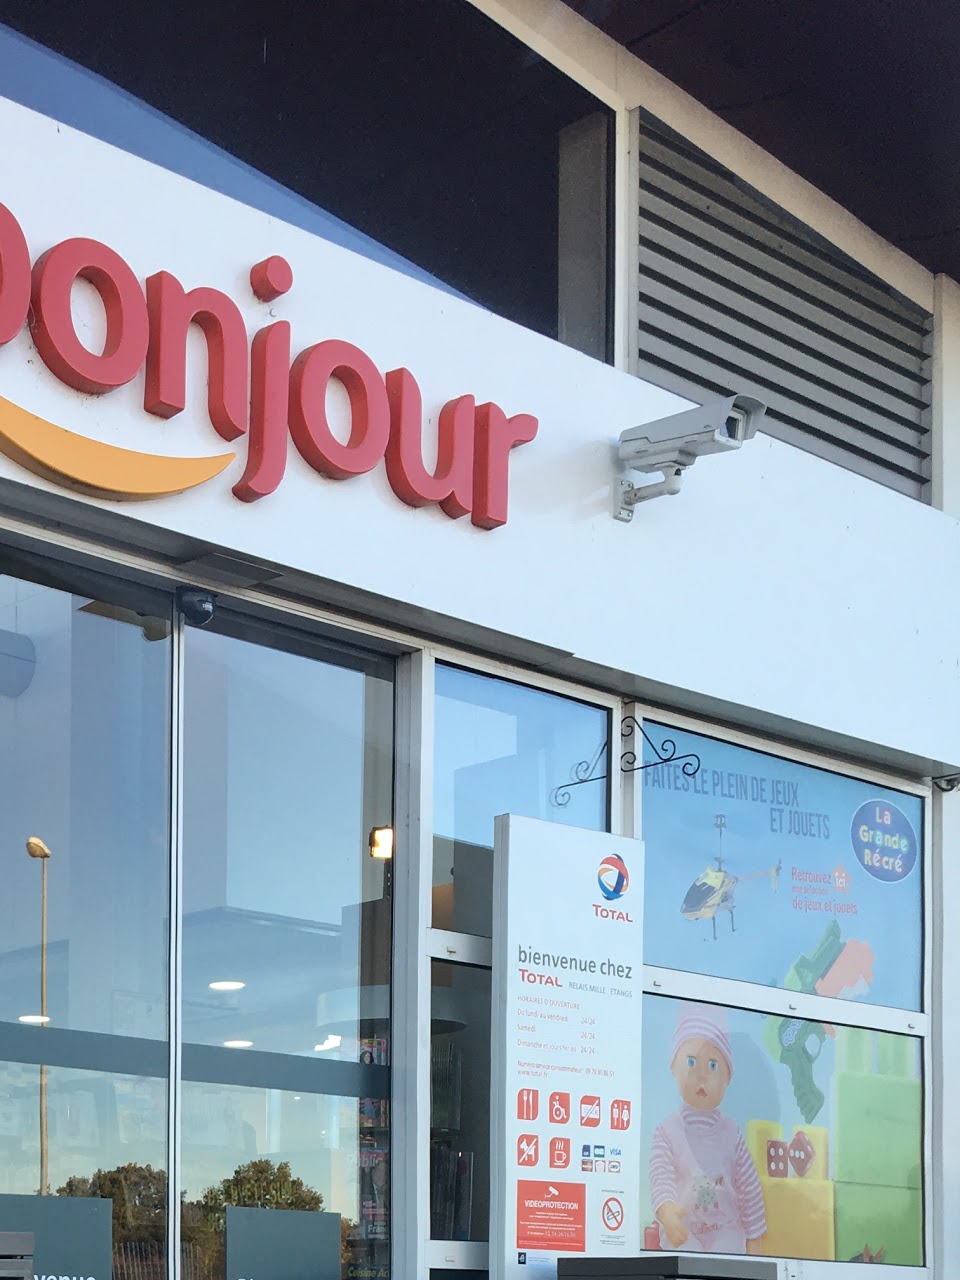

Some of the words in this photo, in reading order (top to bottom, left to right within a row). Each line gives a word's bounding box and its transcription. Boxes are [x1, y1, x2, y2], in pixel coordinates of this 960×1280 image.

[644, 760, 690, 793] FAITES
[693, 768, 708, 795] LE
[712, 770, 749, 801] PLEIN
[751, 778, 767, 803] DE
[770, 780, 800, 808] JEUX
[770, 808, 783, 833] ET
[788, 811, 830, 839] JOUETS
[875, 806, 892, 825] La
[859, 824, 909, 852] Grande
[863, 848, 903, 873] Récré
[792, 866, 831, 885] Retrouvez
[834, 871, 846, 888] ici
[592, 903, 633, 923] TOTAL
[792, 896, 803, 910] de
[805, 897, 823, 913] jeux
[518, 944, 597, 974] bienvenue
[600, 958, 633, 979] chez
[518, 968, 563, 988] TOTAL
[568, 981, 589, 992] RELAIS
[524, 1199, 579, 1210] VIDEOPROTECTION
